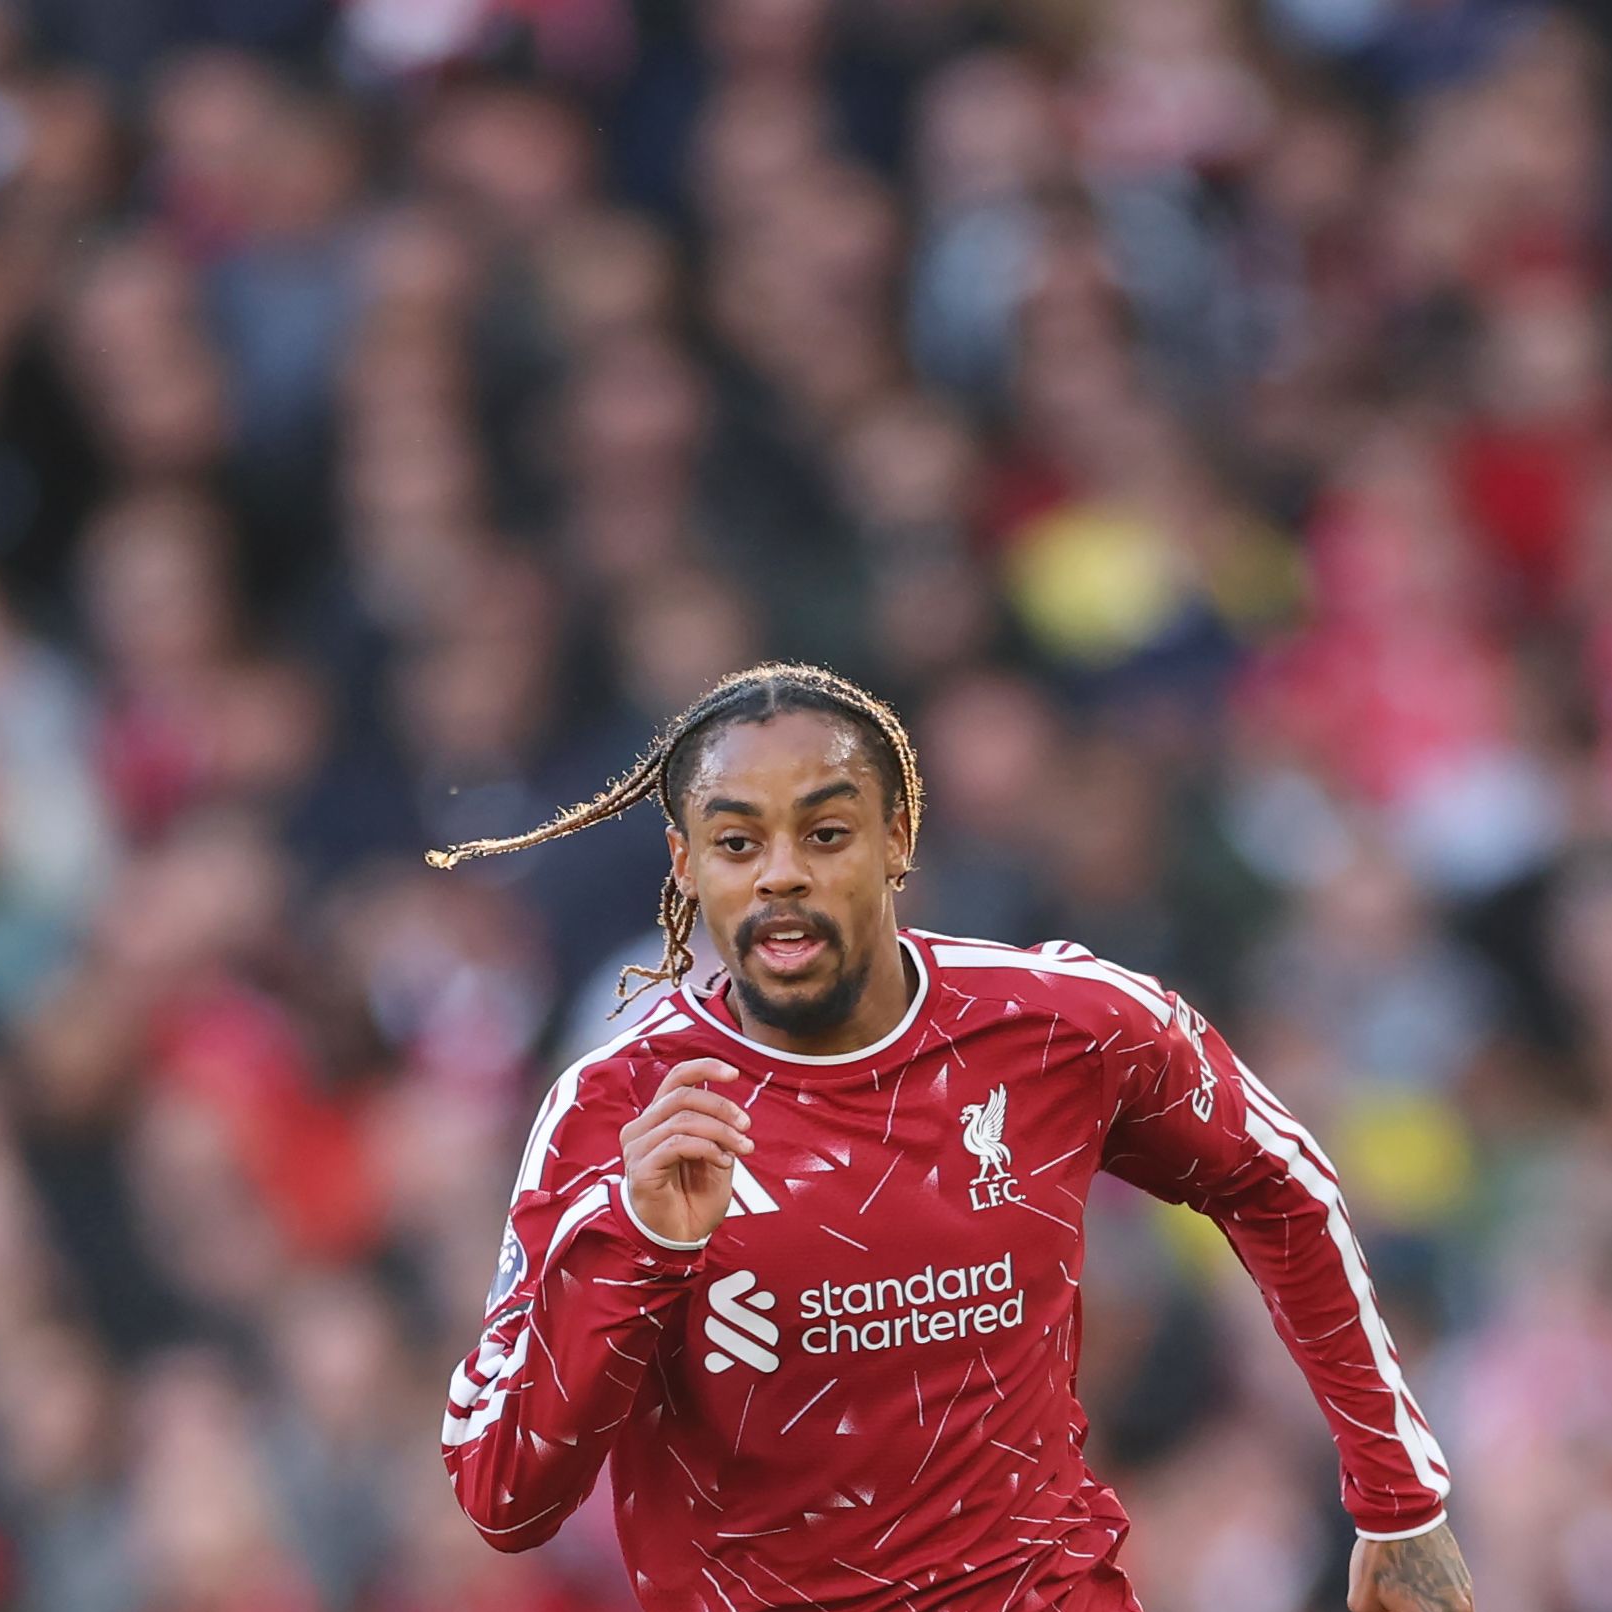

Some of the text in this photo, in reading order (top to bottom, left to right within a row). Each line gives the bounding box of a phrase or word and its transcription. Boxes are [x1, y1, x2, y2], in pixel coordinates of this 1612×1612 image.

[968, 1178, 1027, 1212] L.F.C.
[800, 1251, 1013, 1320] standard
[800, 1289, 1025, 1355] chartered
